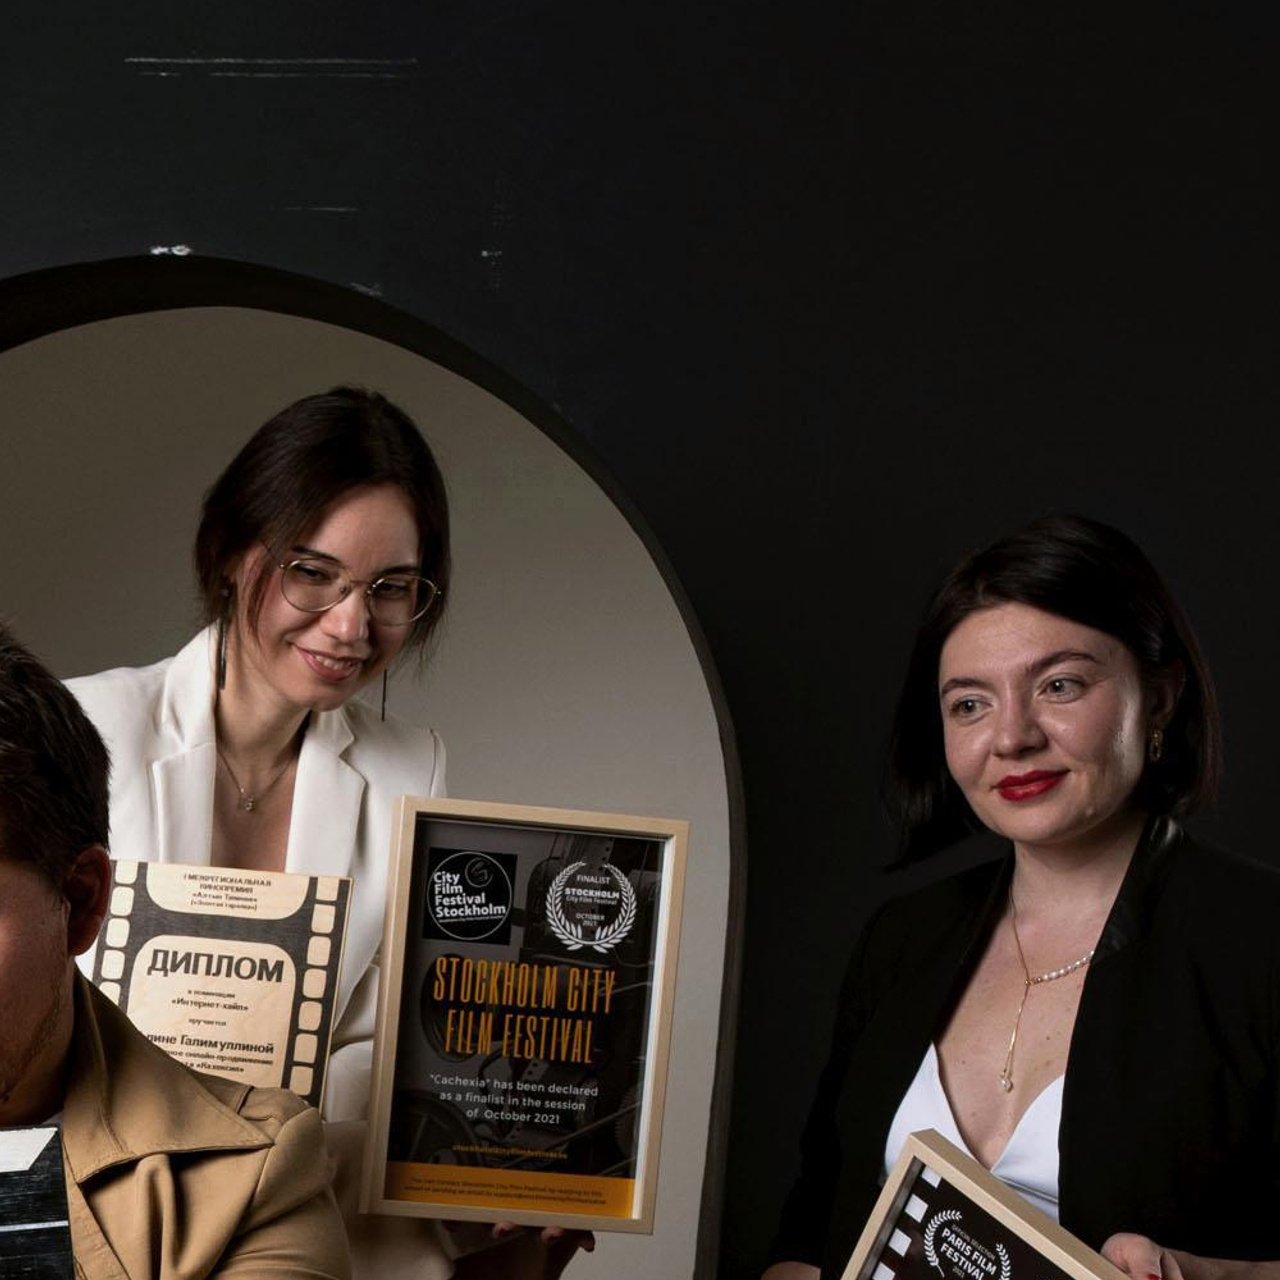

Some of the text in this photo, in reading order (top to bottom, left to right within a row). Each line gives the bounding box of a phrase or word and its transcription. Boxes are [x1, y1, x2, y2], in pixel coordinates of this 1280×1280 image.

[433, 871, 460, 885] City
[576, 874, 611, 884] FINALIST
[434, 883, 463, 895] Film
[564, 887, 620, 899] STOCKHOLM
[435, 892, 486, 906] Festival
[436, 904, 506, 918] Stockholm
[147, 948, 284, 983] ДИПЛОМ
[433, 957, 616, 1015] STOCKHOLM CITY
[445, 1008, 595, 1065] FILM FESTIVAL
[430, 1074, 598, 1097] "Cachexia" has been declared
[439, 1092, 586, 1111] as a finalist in the session
[466, 1108, 560, 1125] of October 2021
[942, 1227, 997, 1276] PARIS FILM
